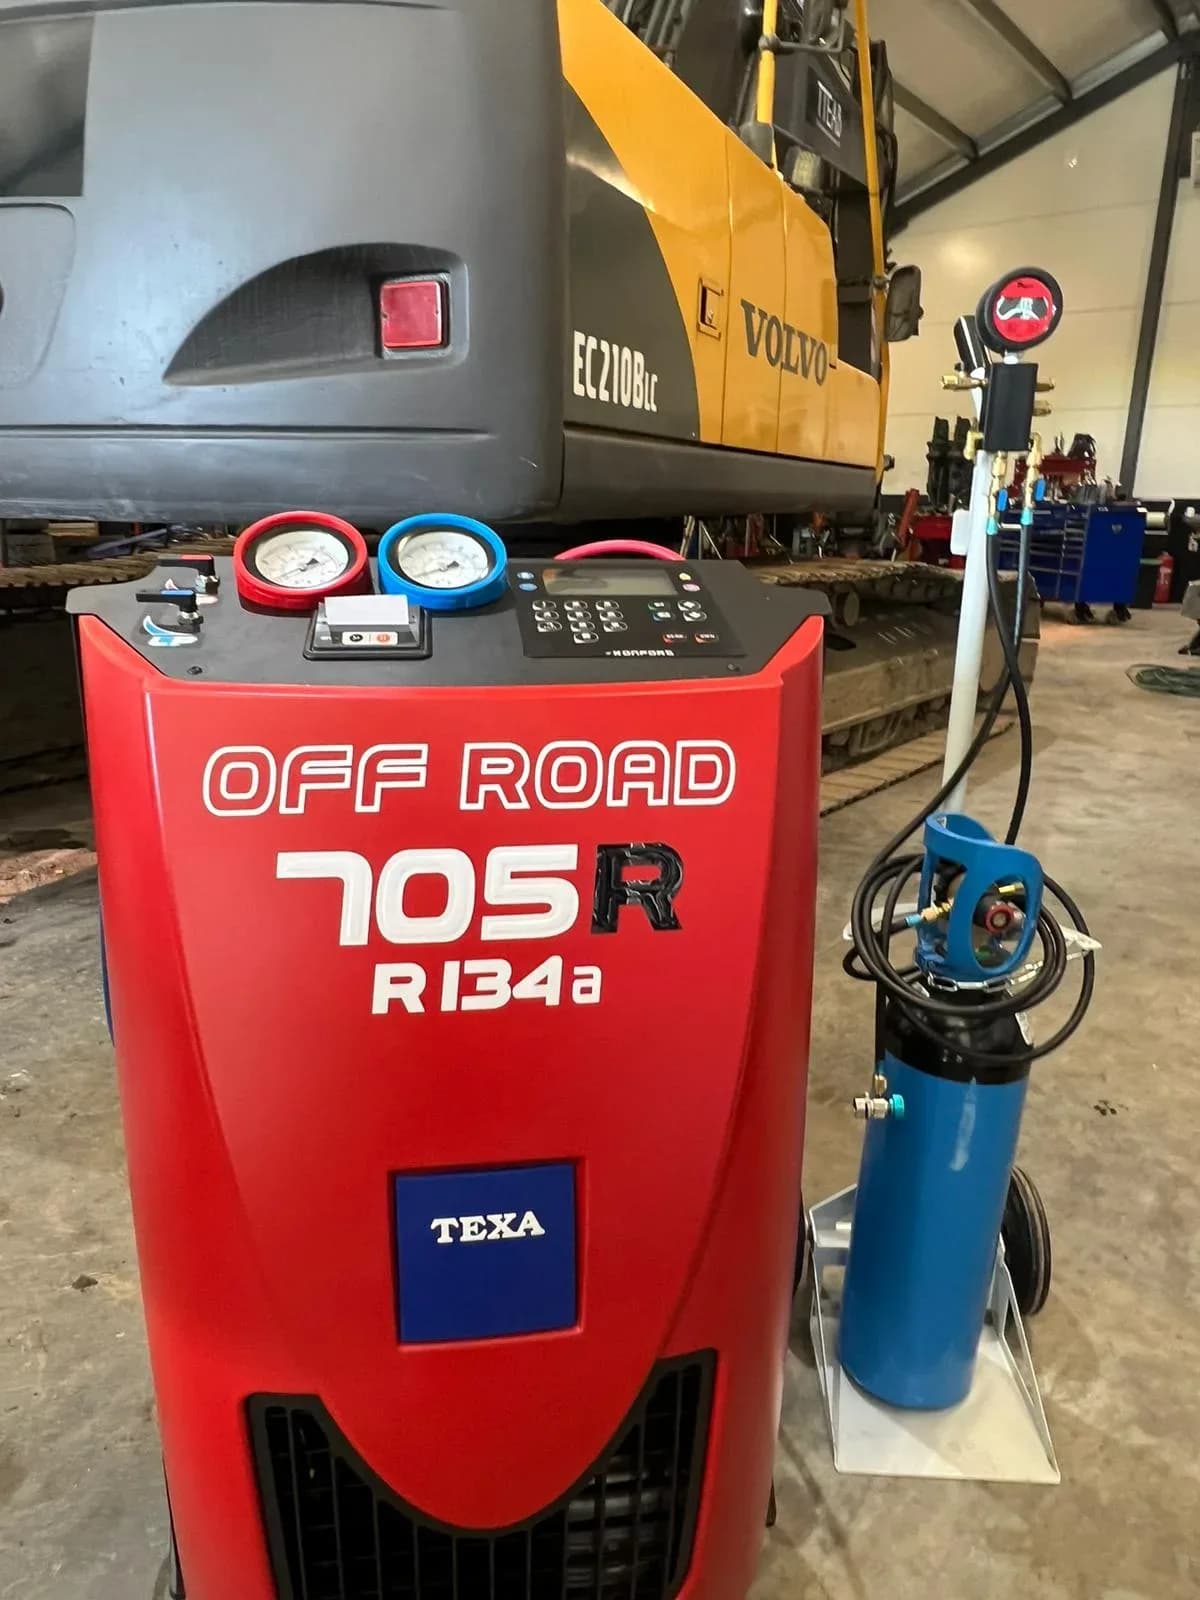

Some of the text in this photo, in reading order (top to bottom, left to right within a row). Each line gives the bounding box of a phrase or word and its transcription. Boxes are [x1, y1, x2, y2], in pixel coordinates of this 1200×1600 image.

[740, 298, 829, 387] VOLVO
[202, 740, 737, 817] OFF ROAD
[430, 1210, 546, 1244] TEXA
